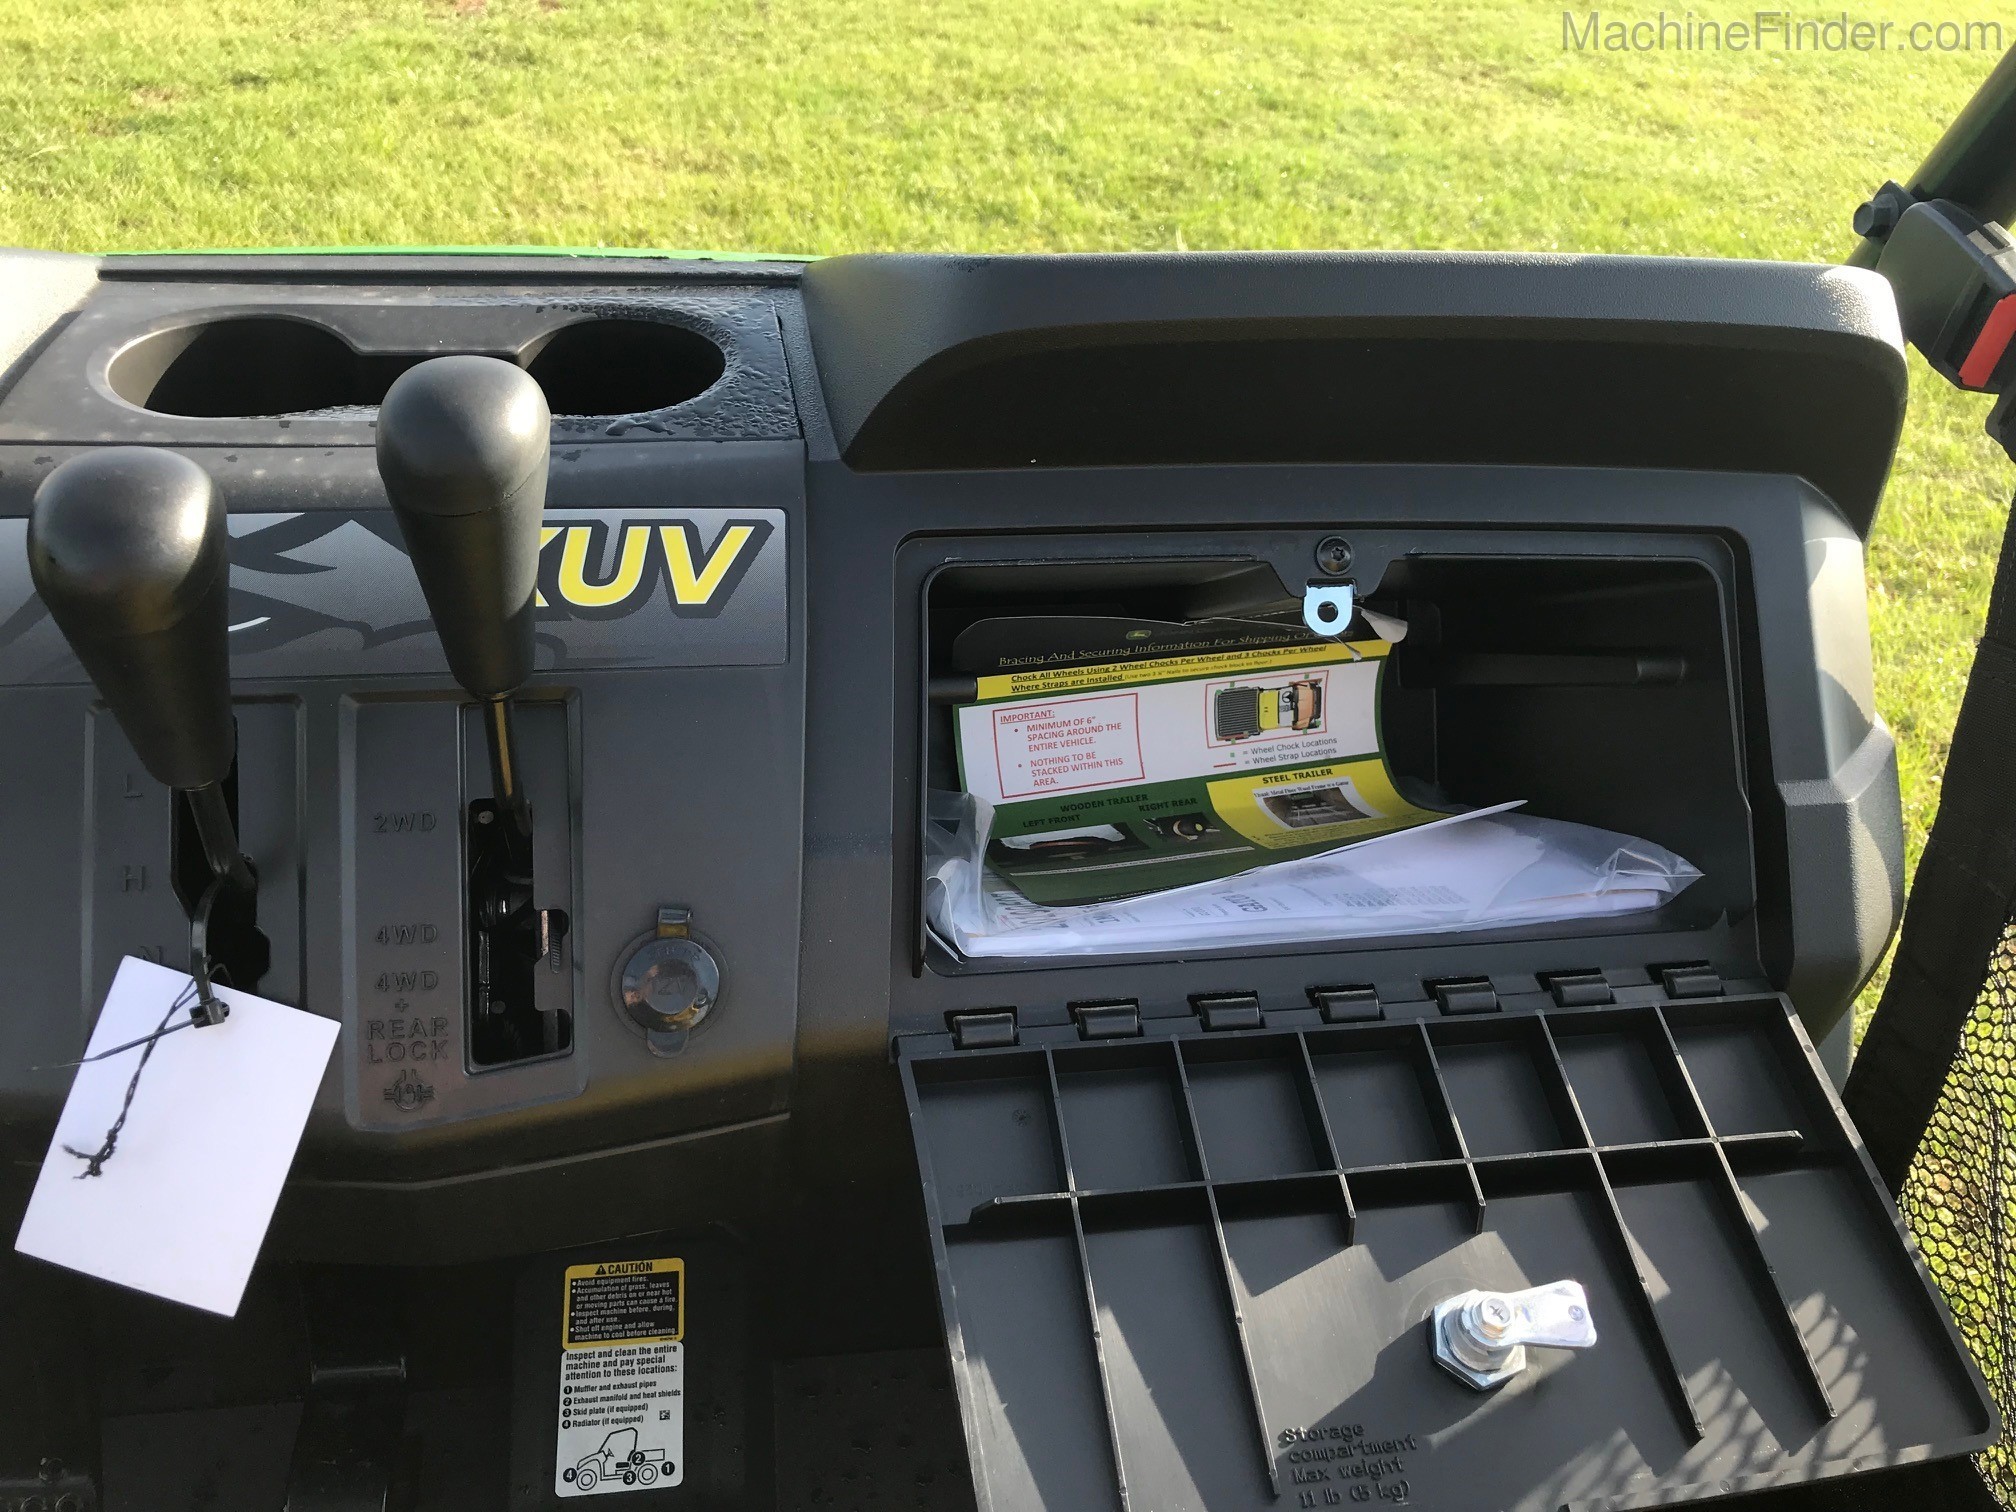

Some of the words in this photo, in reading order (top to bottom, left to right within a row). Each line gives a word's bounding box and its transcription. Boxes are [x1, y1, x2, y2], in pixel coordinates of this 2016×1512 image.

[998, 655, 1045, 666] Bracing
[1047, 650, 1075, 661] And
[1078, 646, 1131, 660] Securing
[1133, 638, 1211, 653] Information
[1213, 637, 1236, 647] For
[1238, 633, 1292, 646] Shipping
[1011, 673, 1038, 683] Chock
[1039, 671, 1051, 680] All
[1053, 668, 1085, 678] Wheels
[1086, 666, 1111, 676] Using
[1112, 664, 1118, 672] 2
[1119, 661, 1148, 671] Wheel
[1149, 659, 1179, 668] Chocks
[1180, 657, 1196, 665] Per
[1196, 653, 1225, 662] Wheel
[1226, 651, 1243, 660] and
[1244, 650, 1250, 658] 3
[1251, 648, 1282, 658] Chocks
[1283, 646, 1299, 655] Per
[1299, 644, 1327, 653] Wheel
[1011, 683, 1041, 692] Where
[1041, 680, 1070, 690] Straps
[1070, 678, 1085, 686] are
[1086, 674, 1124, 684] Installed
[1000, 709, 1055, 723] IMPORTANT:
[1026, 720, 1072, 732] MINIMUM
[1073, 717, 1085, 726] OF
[1086, 716, 1096, 725] 6"
[1027, 730, 1065, 742] SPACING
[1066, 724, 1104, 737] AROUND
[1106, 722, 1122, 731] THE
[1028, 741, 1058, 752] ENTIRE
[1060, 736, 1097, 748] VEHICLE.
[1250, 744, 1275, 755] Wheel
[1276, 741, 1300, 752] Chock
[1301, 737, 1338, 748] Locations
[1030, 756, 1070, 767] NOTHING
[1072, 753, 1084, 762] TO
[1086, 751, 1097, 760] BE
[1252, 754, 1277, 765] Wheel
[1278, 752, 1300, 763] Strap
[1301, 747, 1337, 759] Locations
[1031, 765, 1069, 777] STACKED
[1071, 760, 1103, 772] WITHIN
[1104, 757, 1124, 767] THIS
[1033, 778, 1059, 787] AREA.
[1262, 774, 1291, 784] STEEL
[1292, 768, 1334, 780] TRAILER
[124, 773, 144, 799] L
[1060, 799, 1105, 813] WOODEN
[1106, 793, 1149, 805] TRAILER
[1138, 801, 1170, 812] RIGHT
[1171, 797, 1198, 808] REAR
[373, 812, 437, 834] 2WD
[1022, 817, 1047, 828] LEFT
[1049, 813, 1081, 825] FRONT
[122, 865, 146, 892] H
[375, 923, 439, 945] 4WD
[375, 970, 439, 992] 4WD
[367, 1017, 449, 1041] REAR
[367, 1039, 449, 1065] LOCK
[608, 1262, 653, 1275] CAUTION
[576, 1279, 596, 1287] Avoid
[596, 1276, 631, 1286] equipment
[576, 1285, 620, 1294] Accumulation
[649, 1281, 670, 1289] leaves
[590, 1293, 606, 1301] other
[607, 1291, 628, 1300] debris
[575, 1309, 599, 1318] Inspect
[600, 1307, 627, 1315] machine
[584, 1301, 608, 1310] moving
[609, 1300, 625, 1308] parts
[575, 1325, 590, 1333] Shut
[591, 1324, 600, 1332] off
[601, 1323, 623, 1332] engine
[624, 1321, 637, 1329] and
[637, 1320, 655, 1328] allow
[589, 1316, 605, 1324] after
[574, 1332, 602, 1341] machine
[603, 1331, 610, 1339] to
[611, 1330, 625, 1338] cool
[626, 1328, 647, 1337] before
[648, 1327, 678, 1336] cleaning.
[566, 1351, 596, 1361] Inspect
[597, 1349, 612, 1358] and
[614, 1347, 637, 1357] clean
[639, 1346, 651, 1355] the
[653, 1344, 678, 1354] entire
[565, 1360, 601, 1371] machine
[603, 1359, 618, 1368] and
[620, 1358, 635, 1368] pay
[636, 1355, 666, 1366] special
[565, 1370, 602, 1381] attention
[603, 1370, 612, 1378] to
[613, 1368, 636, 1377] these
[637, 1364, 678, 1376] locations:
[573, 1384, 597, 1394] Muffler
[598, 1383, 611, 1391] and
[612, 1381, 638, 1390] exhaust
[638, 1380, 657, 1389] pipes
[573, 1396, 599, 1405] Exhaust
[600, 1393, 628, 1402] manifold
[629, 1392, 641, 1400] and
[642, 1391, 657, 1399] heat
[657, 1389, 681, 1398] shields
[573, 1407, 588, 1417] Skid
[588, 1405, 606, 1415] plate
[606, 1404, 614, 1415] (if
[615, 1403, 649, 1413] equipped)
[572, 1418, 601, 1428] Radiator
[602, 1417, 610, 1427] (if
[611, 1415, 644, 1425] equipped)
[1284, 1423, 1365, 1443] Storage
[1288, 1433, 1418, 1464] compartment
[1292, 1467, 1332, 1485] Max
[1339, 1456, 1405, 1481] weight
[1299, 1489, 1317, 1509] 11
[1323, 1487, 1342, 1505] lb
[1375, 1479, 1411, 1503] kg)
